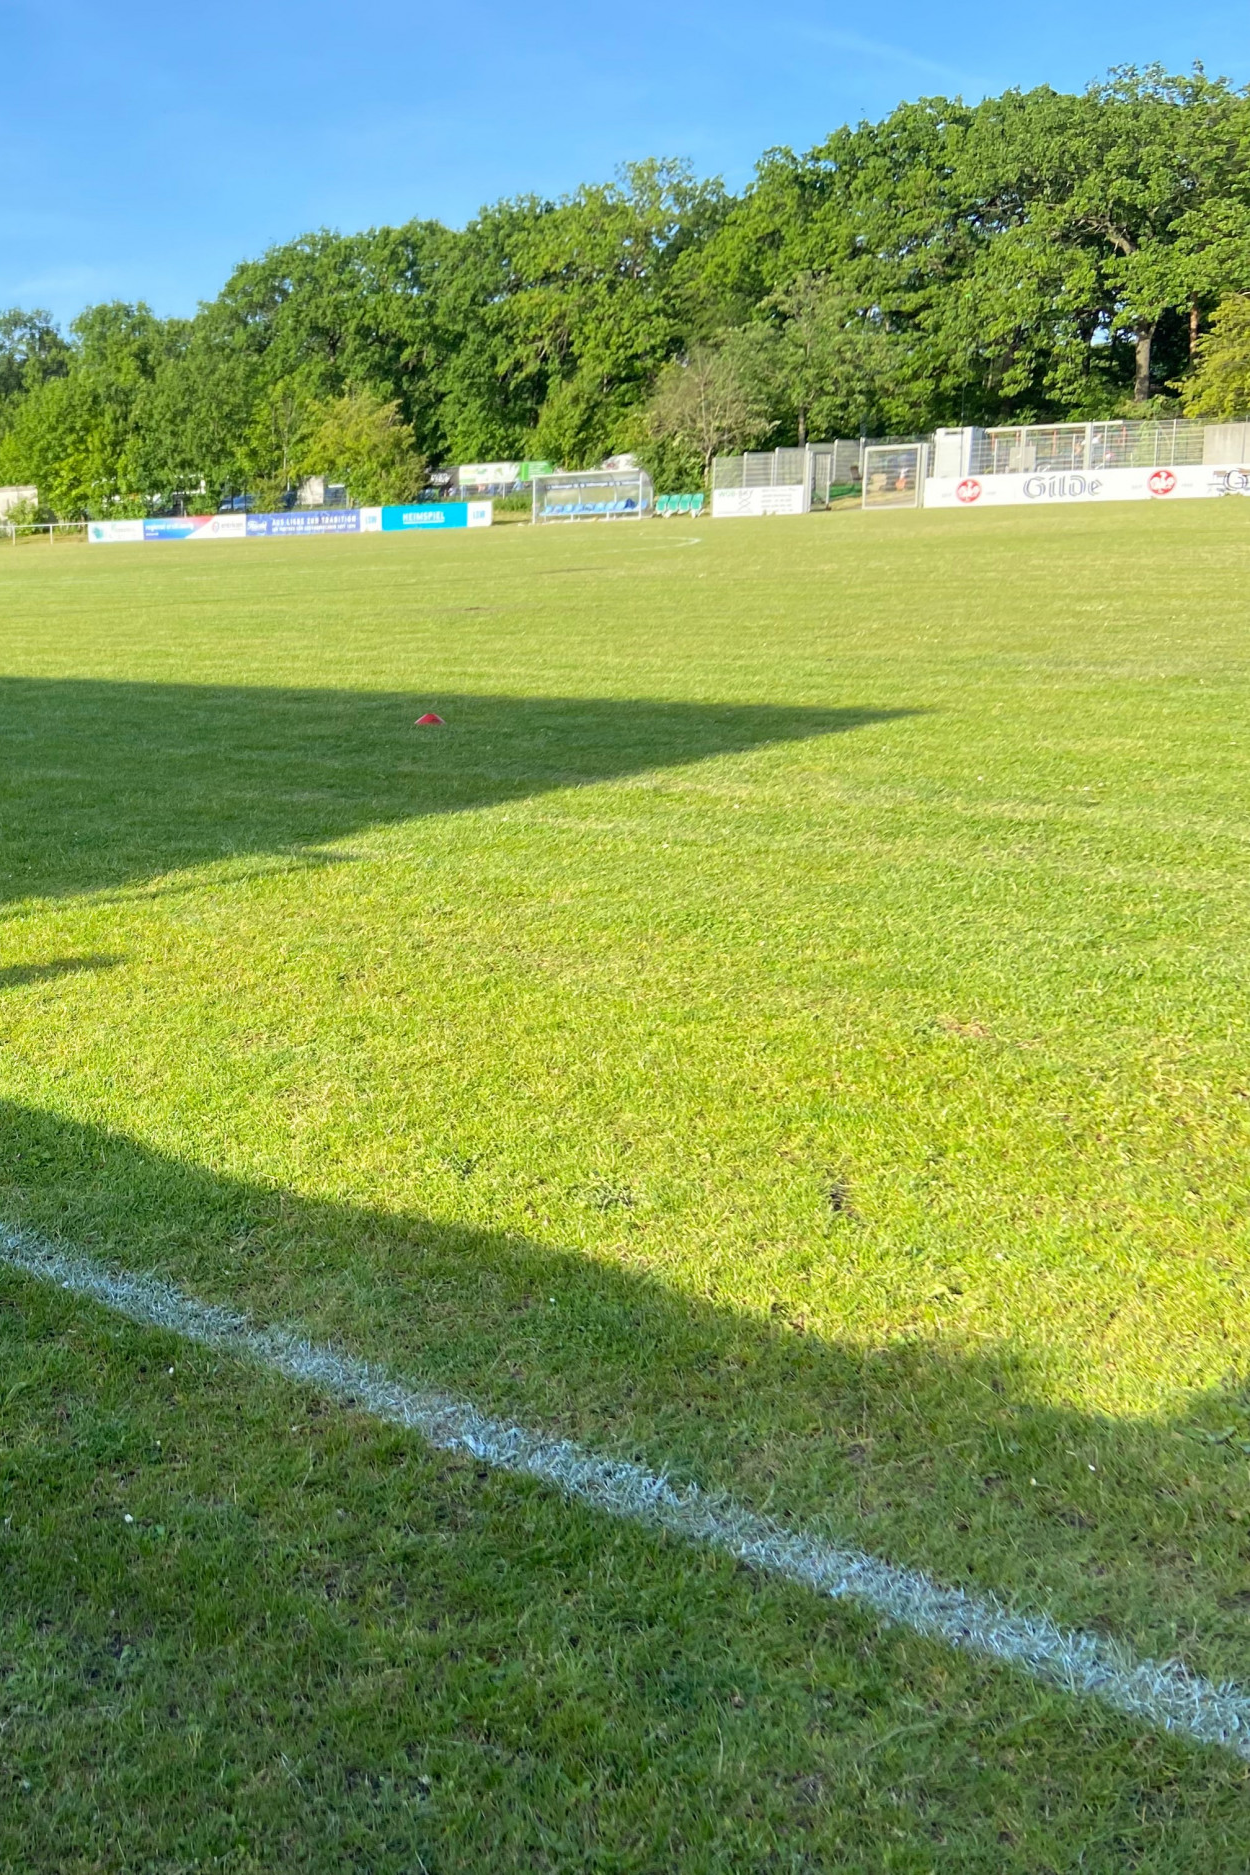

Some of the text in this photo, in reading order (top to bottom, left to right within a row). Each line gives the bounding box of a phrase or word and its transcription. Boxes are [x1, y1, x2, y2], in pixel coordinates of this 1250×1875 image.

[1023, 475, 1103, 499] Gilde
[321, 515, 357, 524] TRADITION
[402, 510, 445, 524] HEIMSPIEL
